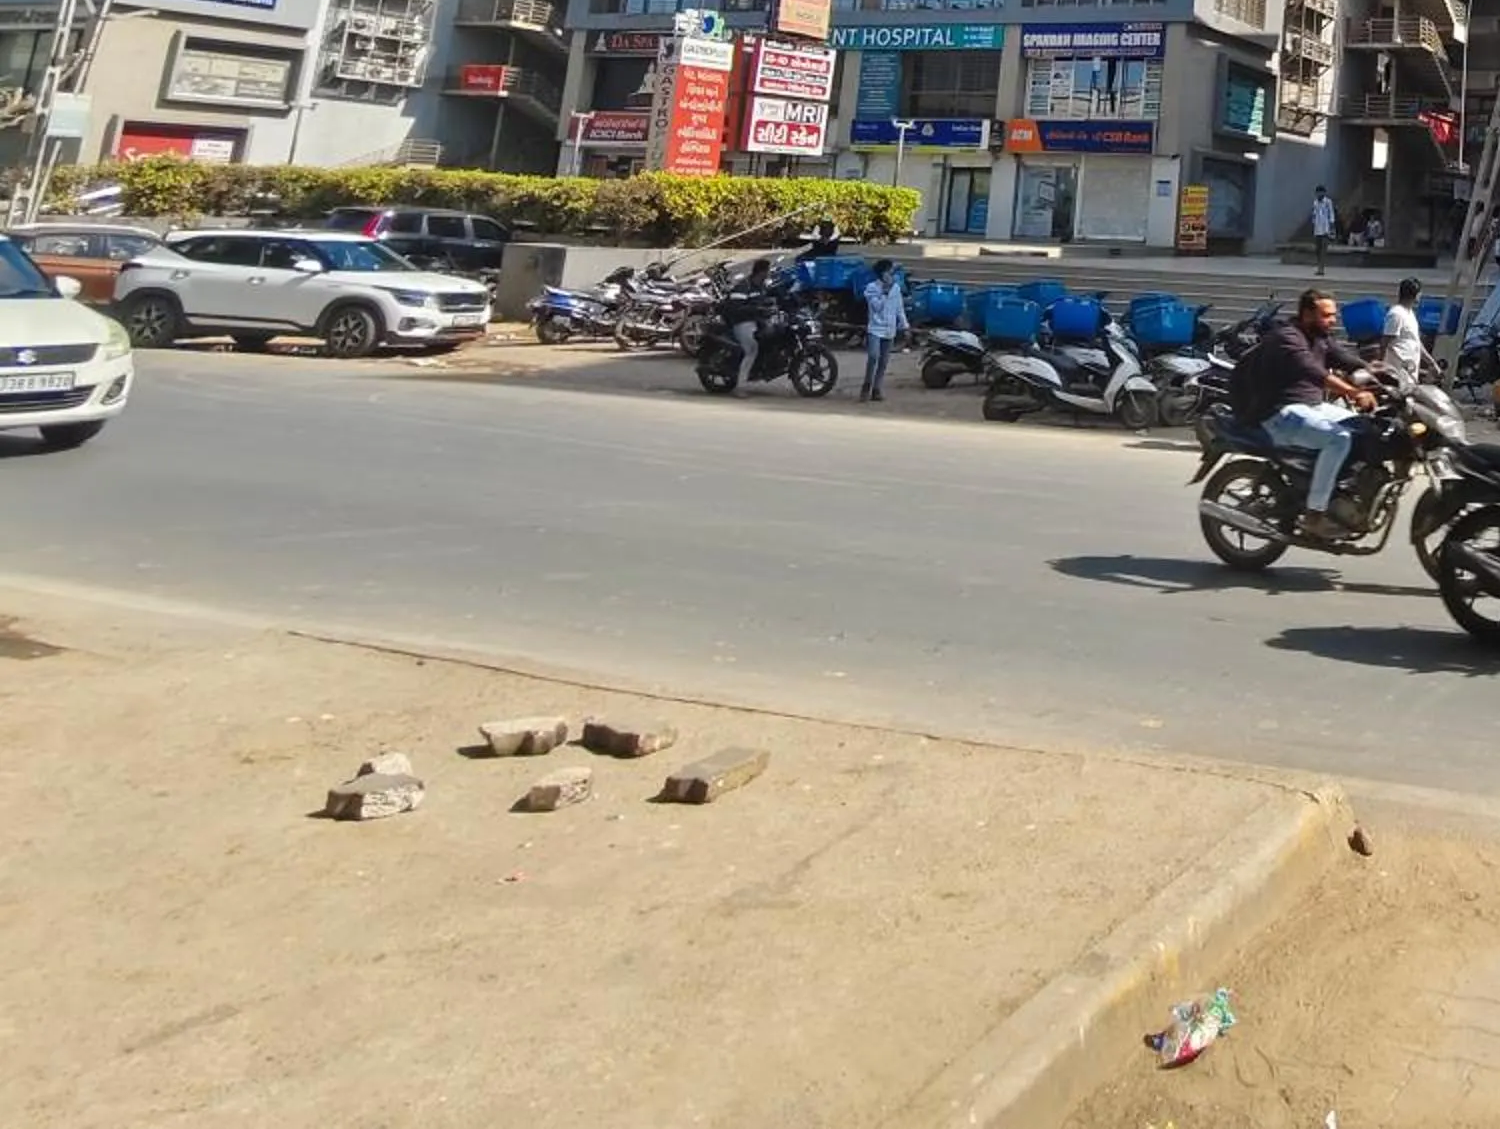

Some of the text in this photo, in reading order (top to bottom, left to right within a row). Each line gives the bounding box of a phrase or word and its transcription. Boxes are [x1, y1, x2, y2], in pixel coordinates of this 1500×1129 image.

[831, 28, 859, 45] NT
[862, 27, 956, 47] HOSPITAL
[1120, 32, 1162, 46] CENTER
[786, 102, 823, 123] MRI
